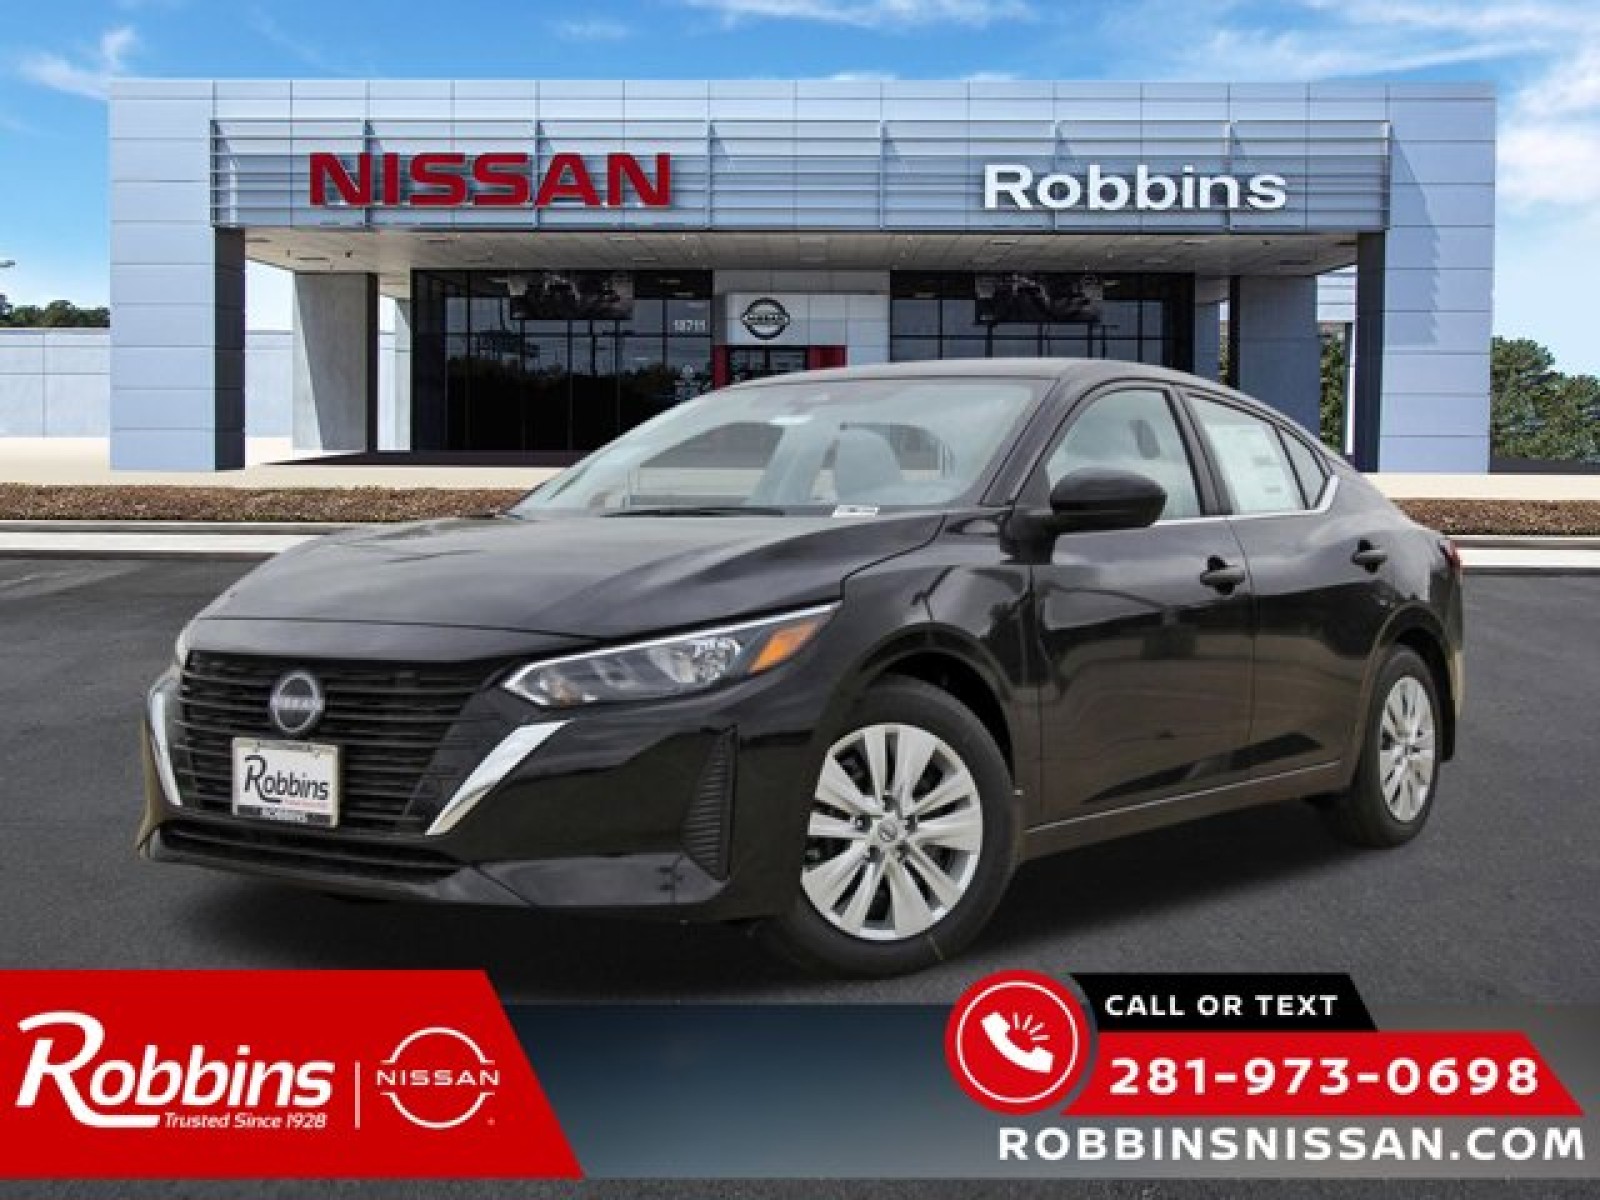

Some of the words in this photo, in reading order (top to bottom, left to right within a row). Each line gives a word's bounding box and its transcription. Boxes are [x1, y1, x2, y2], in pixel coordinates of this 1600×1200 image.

[309, 153, 671, 207] NISSAN
[984, 164, 1287, 211] Robbins
[244, 754, 329, 803] Robbins
